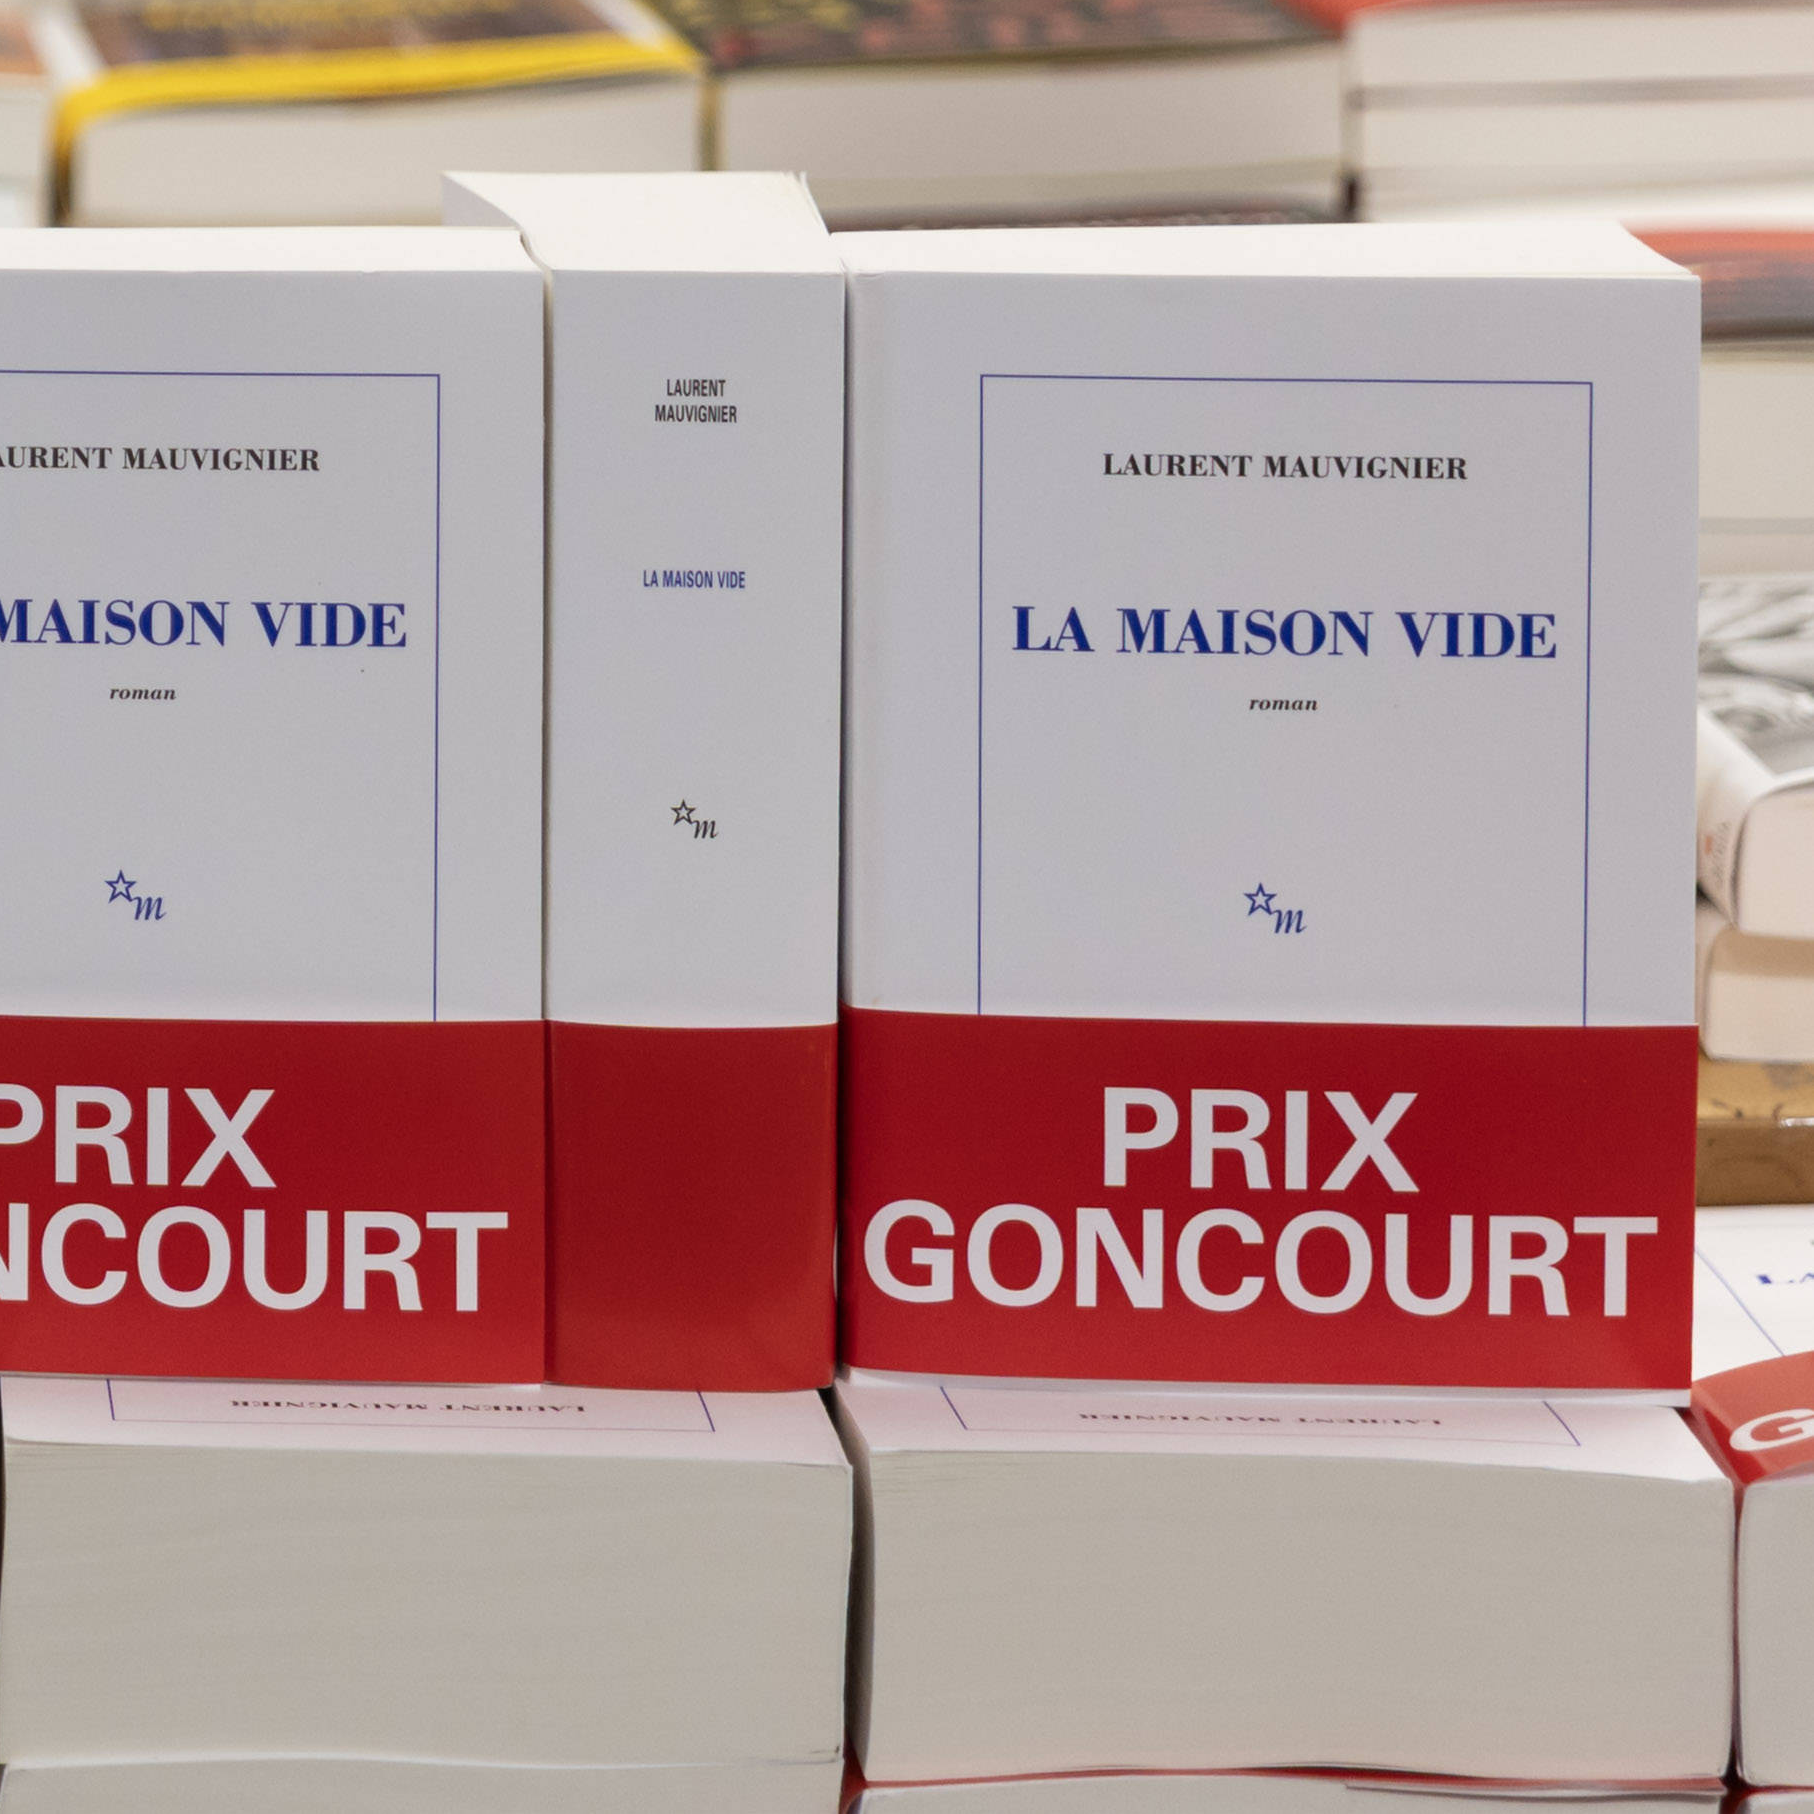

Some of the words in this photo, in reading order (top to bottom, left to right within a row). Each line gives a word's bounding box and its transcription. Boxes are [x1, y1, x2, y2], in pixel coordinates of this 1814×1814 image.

[666, 378, 727, 398] LAURENT
[654, 404, 737, 423] MAUVIGNIER
[122, 447, 320, 473] MAUVIGNIER
[1104, 453, 1252, 478] LAURENT
[1263, 455, 1467, 481] MAUVIGNIER
[643, 569, 658, 588] LA
[662, 570, 713, 588] MAISON
[717, 570, 746, 589] VIDE
[251, 601, 407, 648] VIDE
[1012, 605, 1094, 653] LA
[1116, 608, 1373, 657] MAISON
[1395, 611, 1557, 659] VIDE
[109, 688, 177, 701] roman
[1249, 699, 1318, 712] roman
[1103, 1087, 1420, 1192] PRIX
[863, 1199, 1659, 1317] GONCOURT
[232, 1399, 429, 1411] MAUVIGNIER
[440, 1403, 587, 1413] LAURENT
[1079, 1412, 1283, 1424] MAUVIGNIER
[1293, 1415, 1443, 1426] LAURENT
